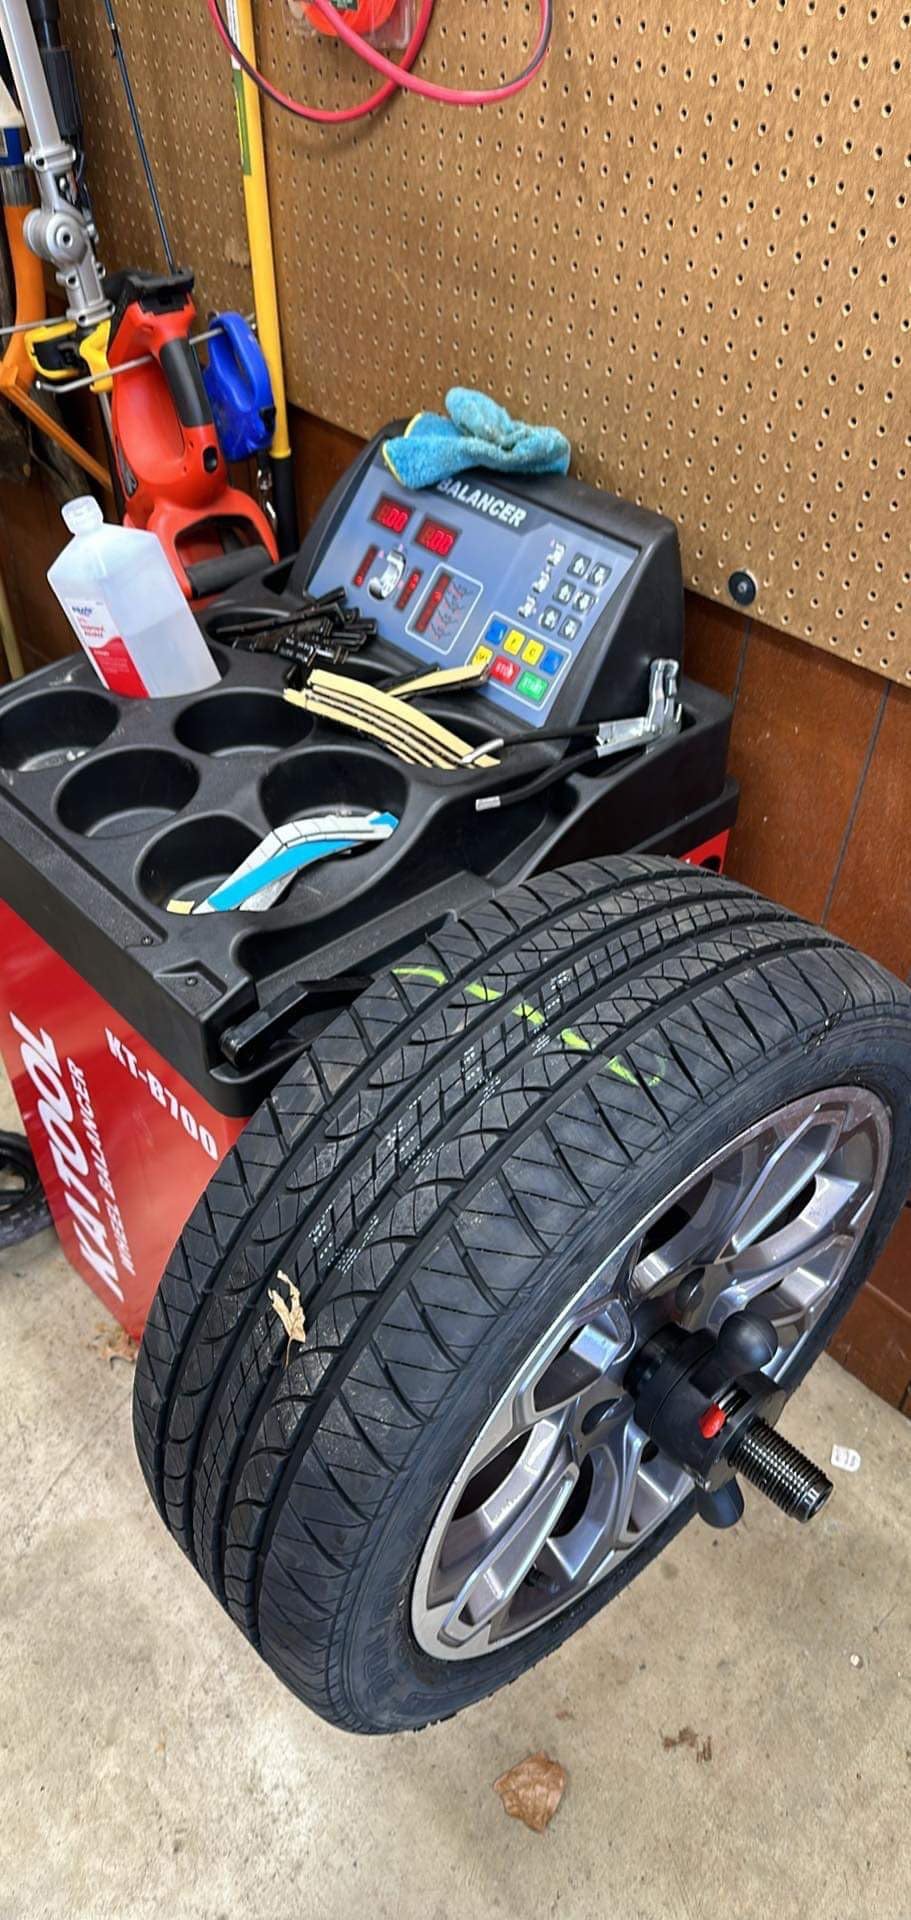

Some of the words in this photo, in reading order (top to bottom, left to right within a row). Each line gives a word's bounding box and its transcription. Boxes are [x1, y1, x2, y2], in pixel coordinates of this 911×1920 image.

[437, 478, 527, 527] BALANCER
[66, 1056, 116, 1200] BALANCER
[104, 1027, 218, 1161] KT-8700
[104, 1197, 136, 1276] WHEEL
